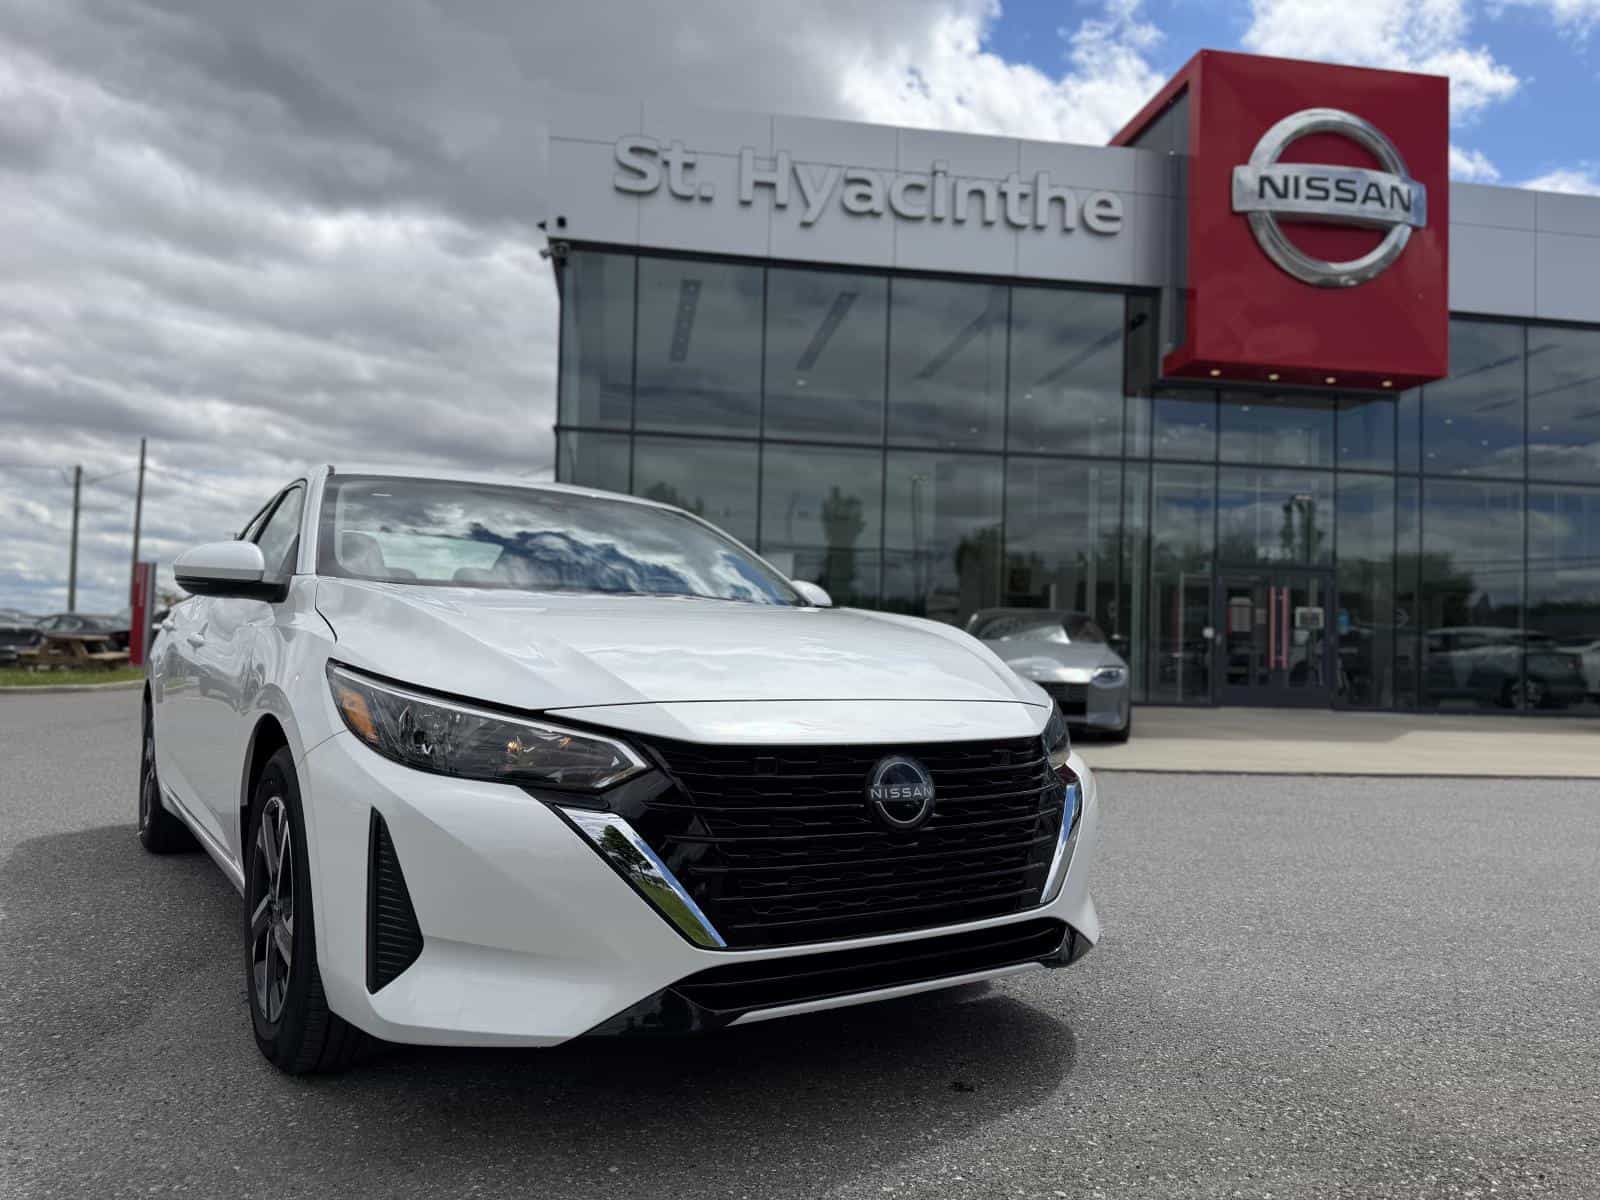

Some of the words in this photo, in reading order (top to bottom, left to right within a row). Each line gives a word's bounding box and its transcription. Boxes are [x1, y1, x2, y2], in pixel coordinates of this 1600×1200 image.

[614, 134, 714, 201] St.
[738, 145, 1123, 236] Hyacinthe
[1258, 175, 1412, 213] NISSAN
[870, 787, 933, 799] NISSAN
